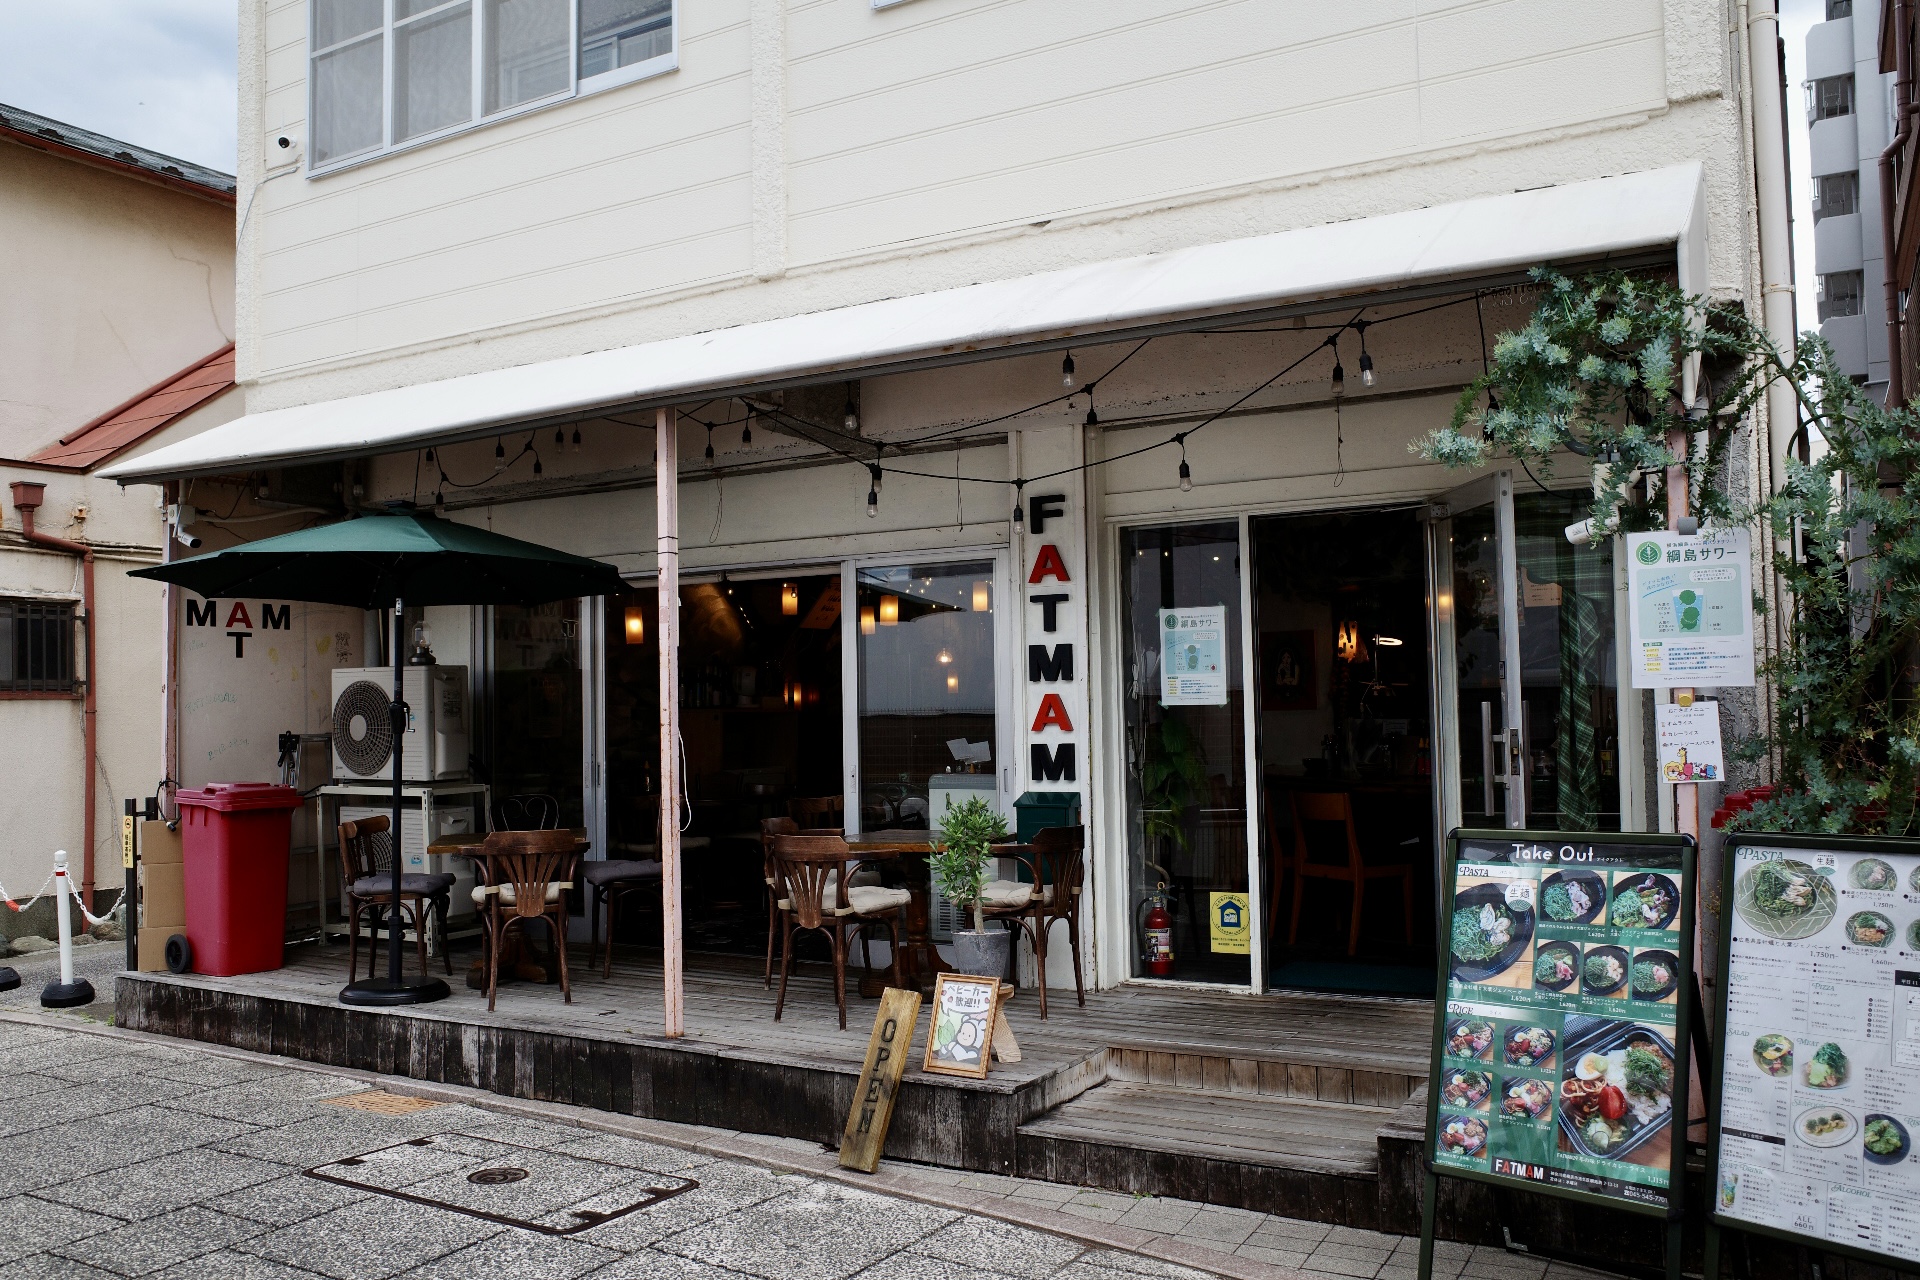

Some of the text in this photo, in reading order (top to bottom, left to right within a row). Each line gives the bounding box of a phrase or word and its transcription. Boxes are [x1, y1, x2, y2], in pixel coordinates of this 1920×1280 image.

[1666, 547, 1737, 563] 綱島サワー
[1181, 619, 1219, 629] 綱島サワー
[1028, 494, 1076, 781] FATMAM
[1511, 843, 1553, 860] Take
[1559, 845, 1594, 862] Out
[1737, 847, 1784, 862] PASTA
[1459, 866, 1489, 877] PASTA
[1509, 887, 1530, 899] 生麺
[947, 985, 989, 996] ベビーカー
[856, 1018, 897, 1134] OPEN
[1495, 1158, 1544, 1180] FATMAM
[1831, 1184, 1872, 1198] ALCOHOL
[1794, 1221, 1814, 1231] 660円
[1796, 1215, 1812, 1224] ALL
